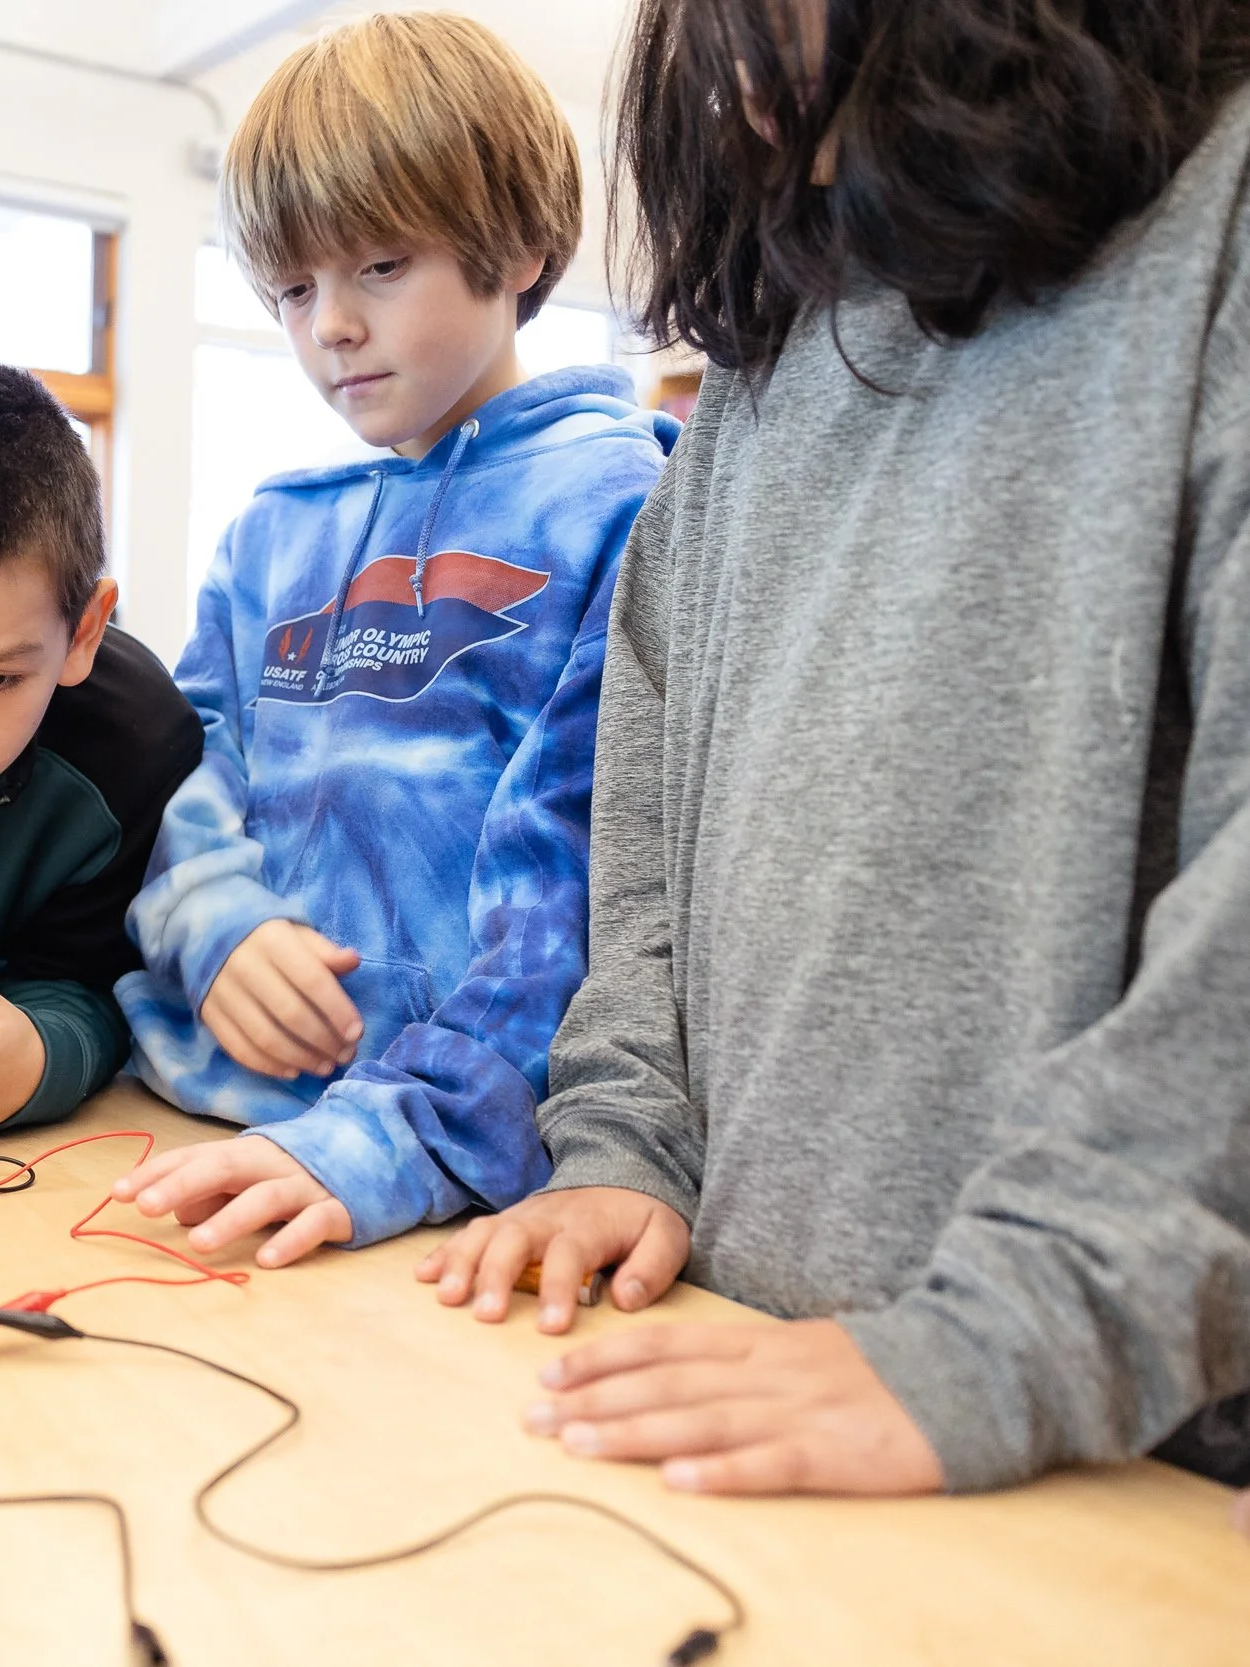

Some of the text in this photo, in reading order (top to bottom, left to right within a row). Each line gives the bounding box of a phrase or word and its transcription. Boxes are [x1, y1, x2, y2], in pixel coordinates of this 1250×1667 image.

[362, 627, 431, 649] OLYMPIC
[331, 642, 430, 666] ROSS COUNTRY
[263, 665, 308, 682] USATF
[272, 680, 304, 691] ENGLAND
